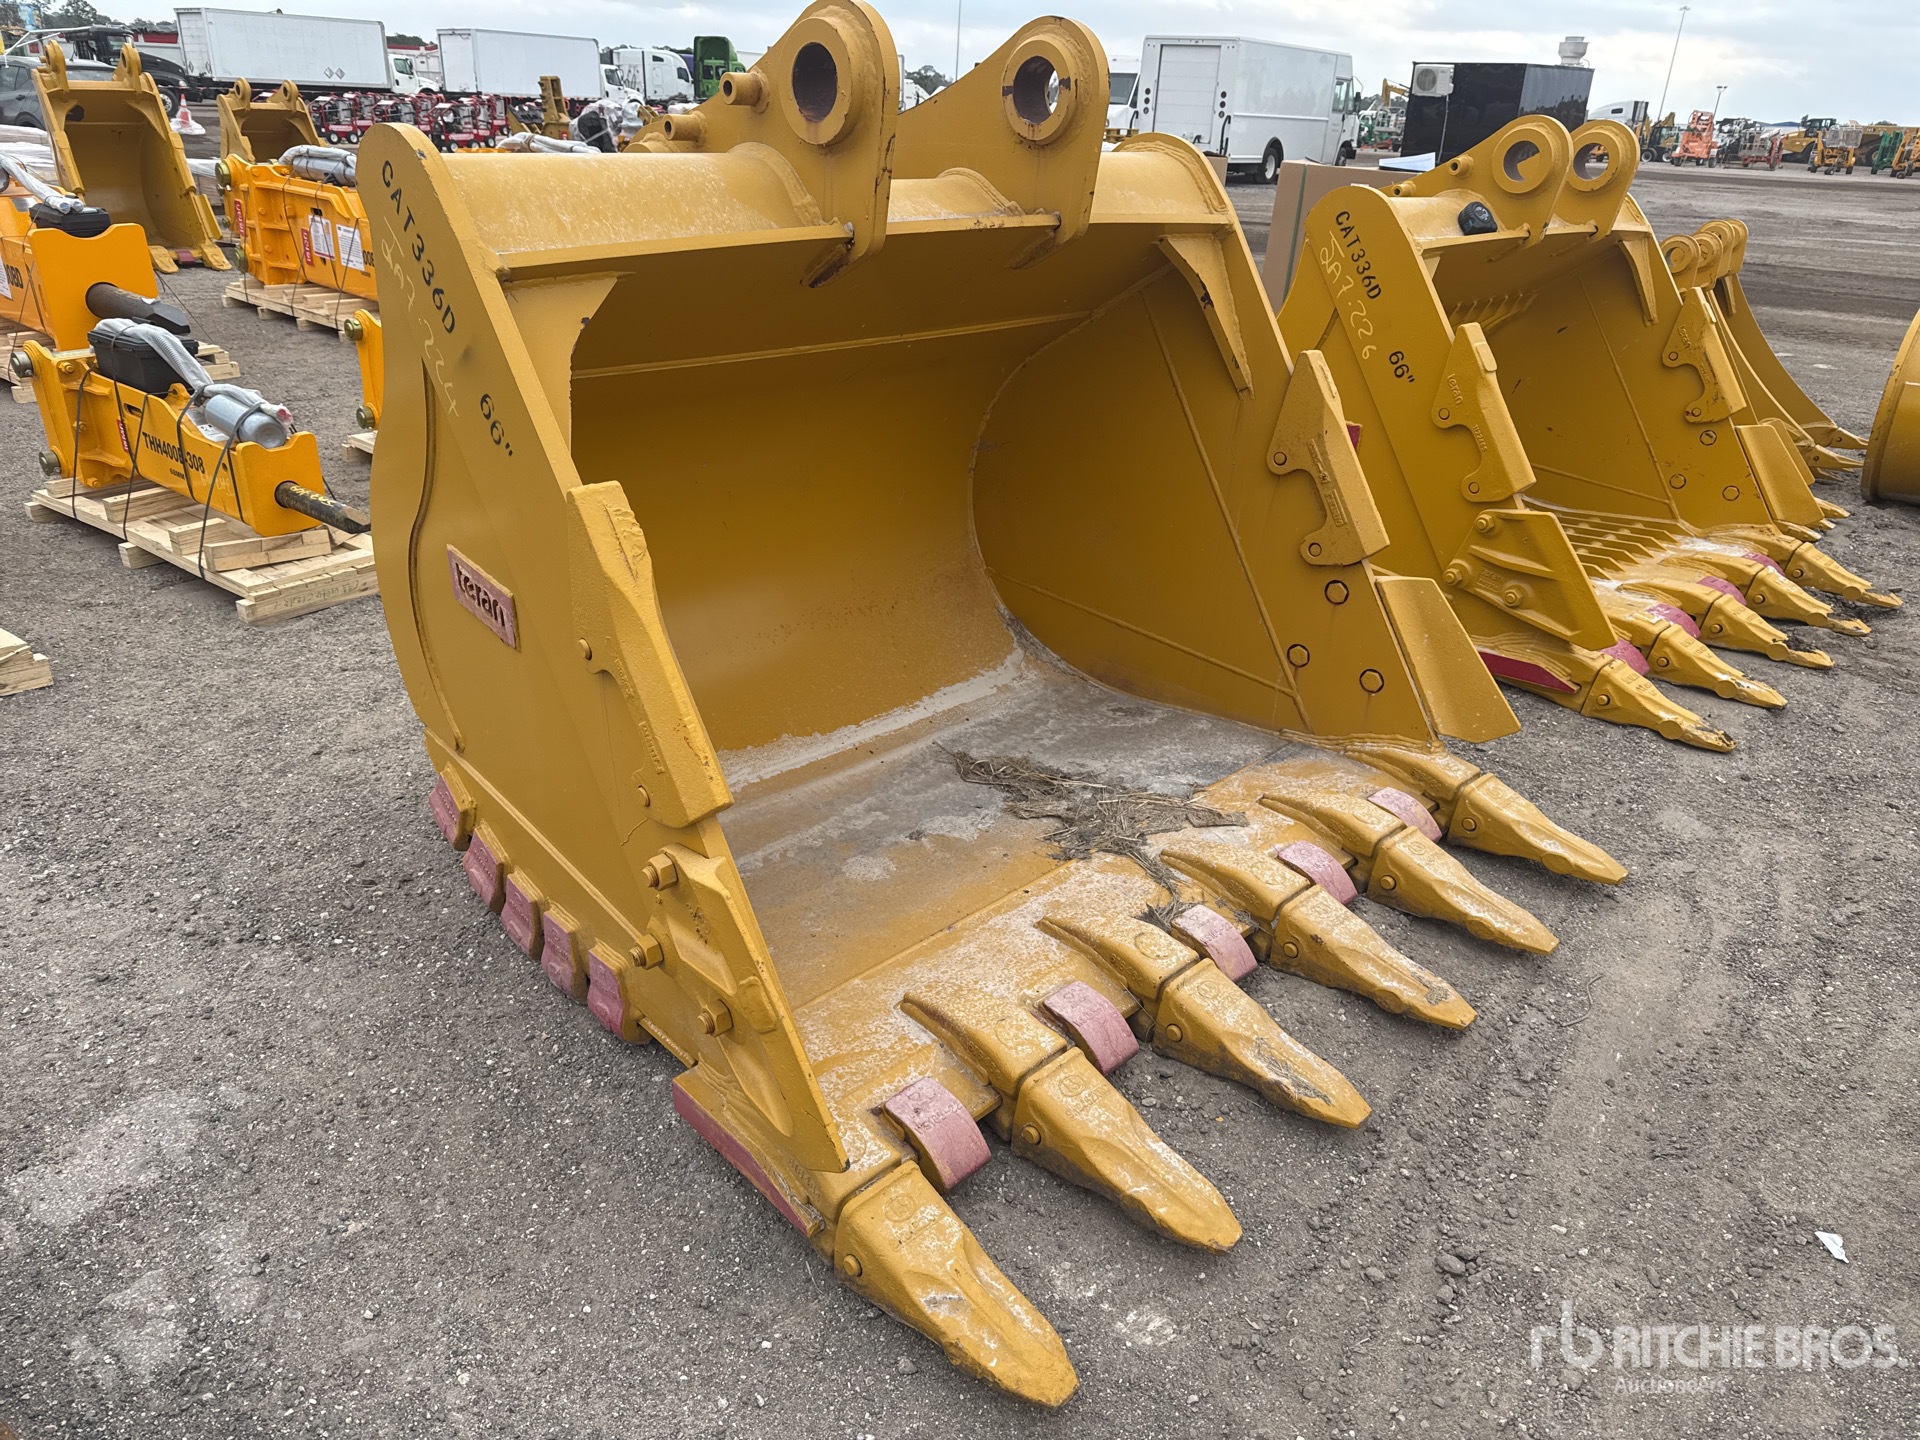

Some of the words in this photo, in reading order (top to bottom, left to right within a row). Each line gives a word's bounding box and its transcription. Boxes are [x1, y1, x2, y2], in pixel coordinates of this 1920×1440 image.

[381, 160, 456, 334] CAT336D
[1335, 210, 1382, 300] CAT336D
[1447, 373, 1464, 405] teran
[455, 562, 506, 628] teran
